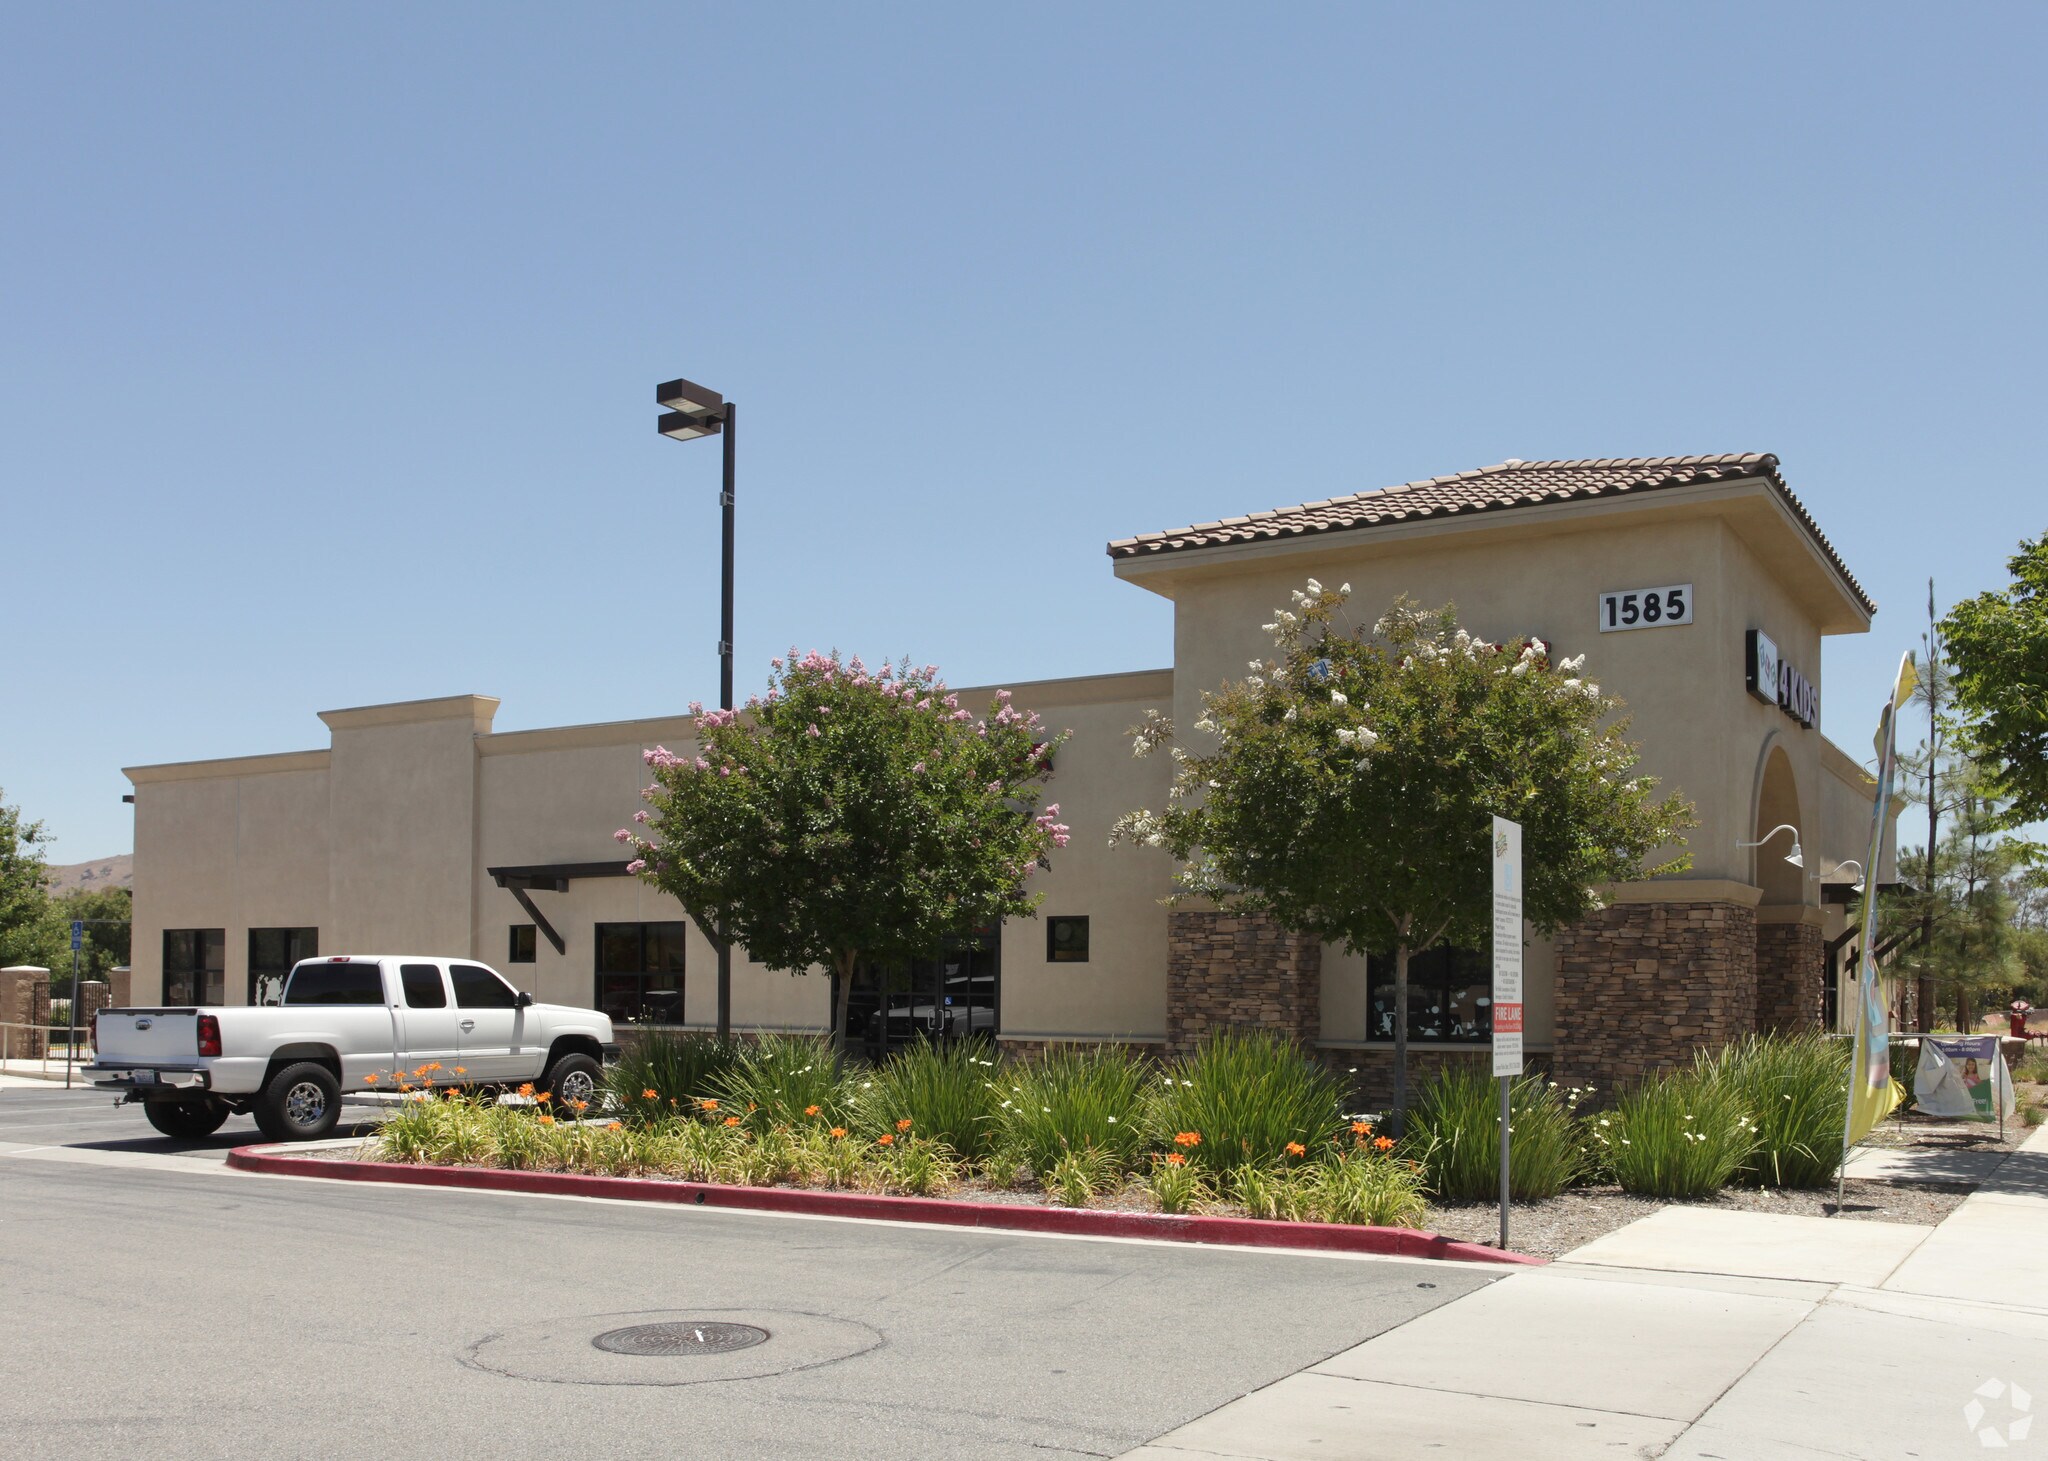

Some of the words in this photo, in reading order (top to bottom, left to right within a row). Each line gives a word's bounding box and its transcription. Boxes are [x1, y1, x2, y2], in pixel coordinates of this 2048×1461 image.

[1606, 589, 1685, 627] 1585
[1789, 666, 1817, 729] KIDS
[1495, 1006, 1507, 1020] FIRE
[1507, 1006, 1521, 1020] LANE
